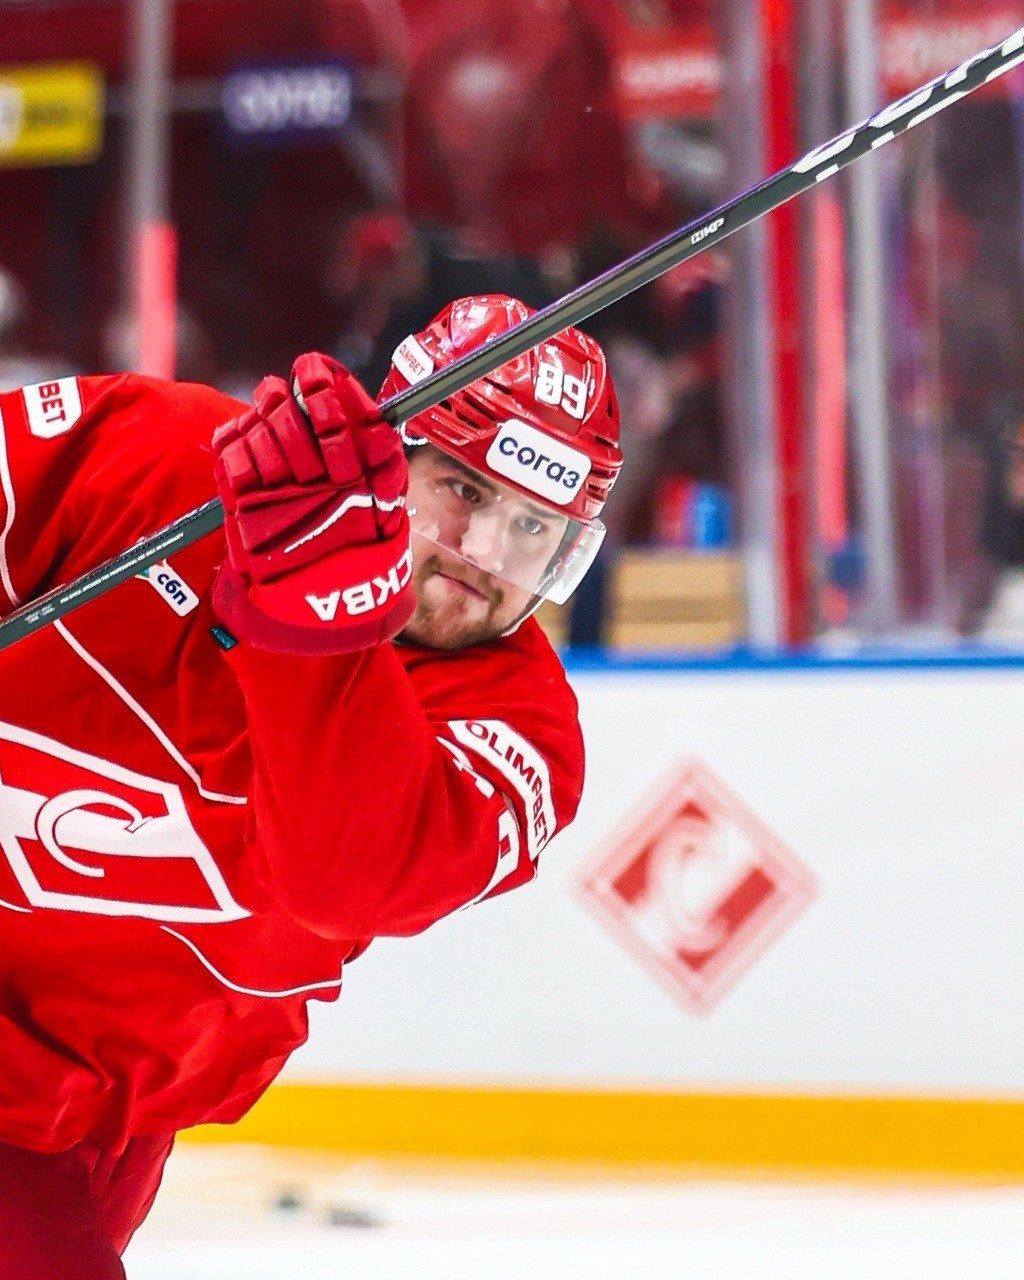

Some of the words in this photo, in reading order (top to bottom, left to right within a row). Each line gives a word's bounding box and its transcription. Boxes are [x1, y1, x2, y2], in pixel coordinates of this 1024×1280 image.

[38, 382, 66, 423] BET
[534, 362, 588, 420] 89
[157, 572, 189, 606] сбп
[465, 721, 548, 849] OLIMPBET
